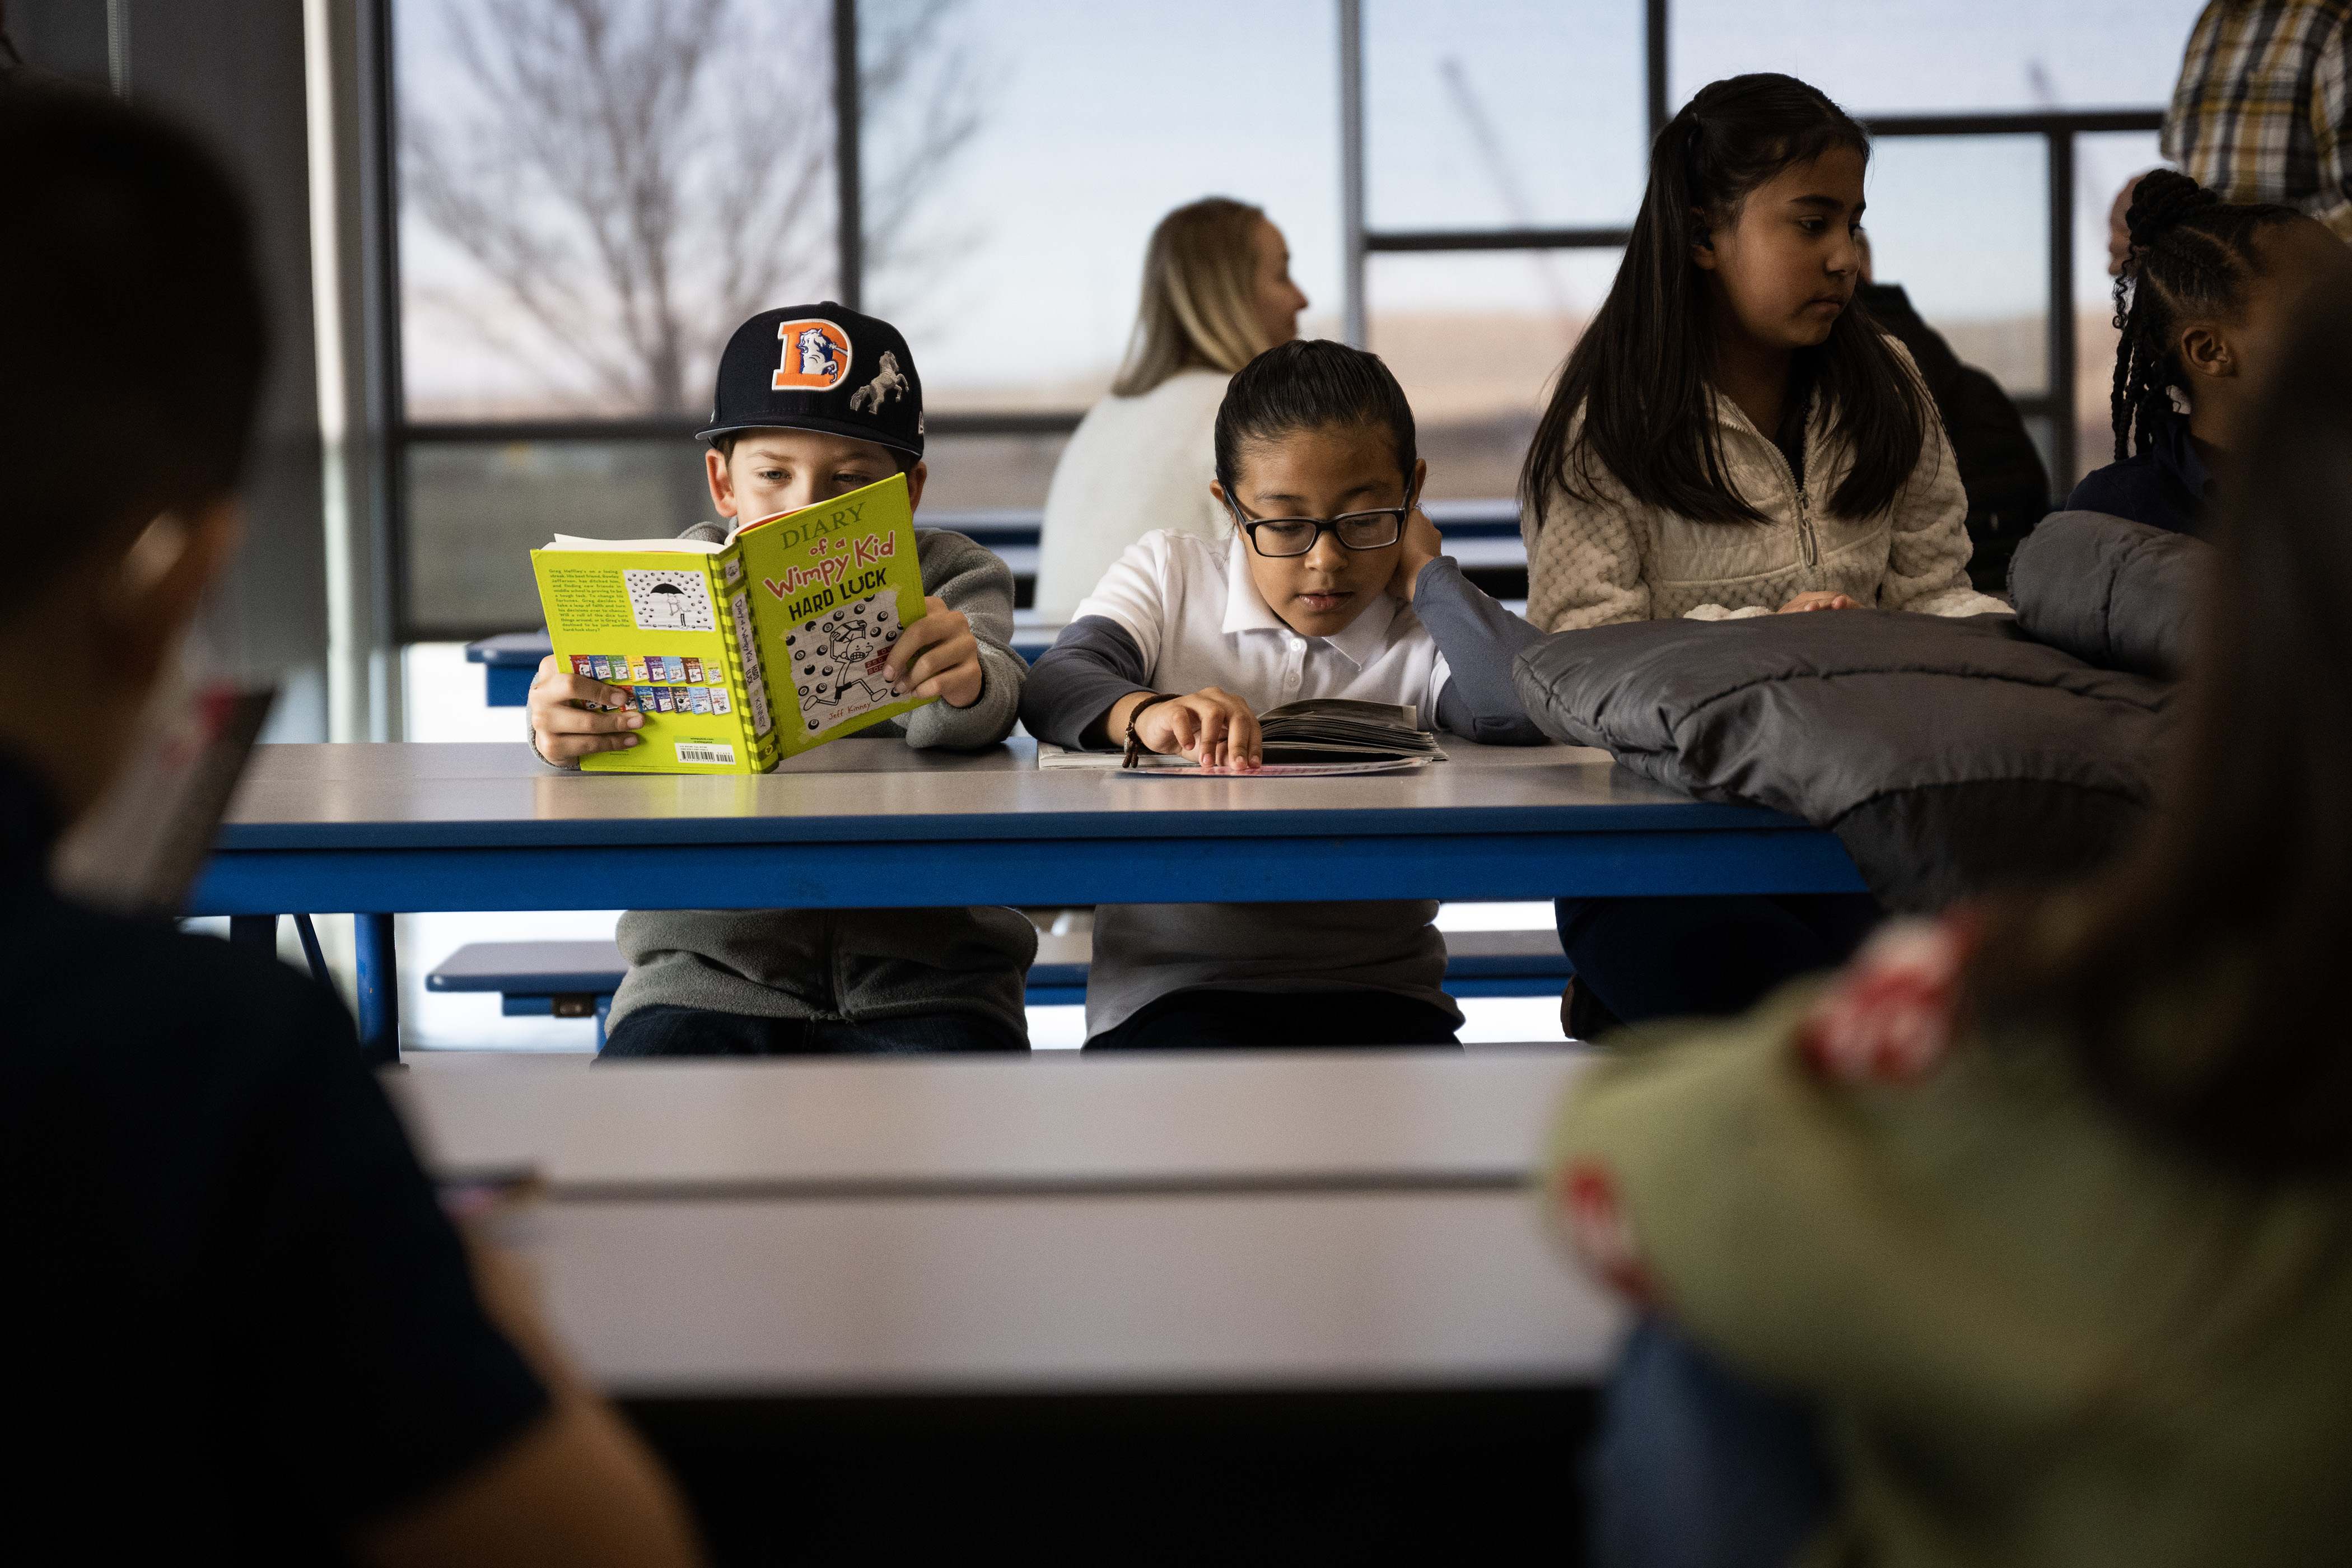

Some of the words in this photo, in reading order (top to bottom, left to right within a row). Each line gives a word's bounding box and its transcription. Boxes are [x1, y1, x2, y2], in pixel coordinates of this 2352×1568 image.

[772, 319, 852, 391] D
[780, 502, 866, 550] DIARY
[764, 554, 850, 600] Wimpy
[853, 530, 895, 568] Kid
[810, 538, 828, 556] of
[835, 538, 846, 549] a
[735, 599, 744, 618] Diary
[788, 589, 834, 622] HARD
[839, 568, 886, 600] LUCK
[755, 697, 766, 727] KINNEY
[829, 709, 843, 720] Jeff
[848, 702, 871, 713] Kinney
